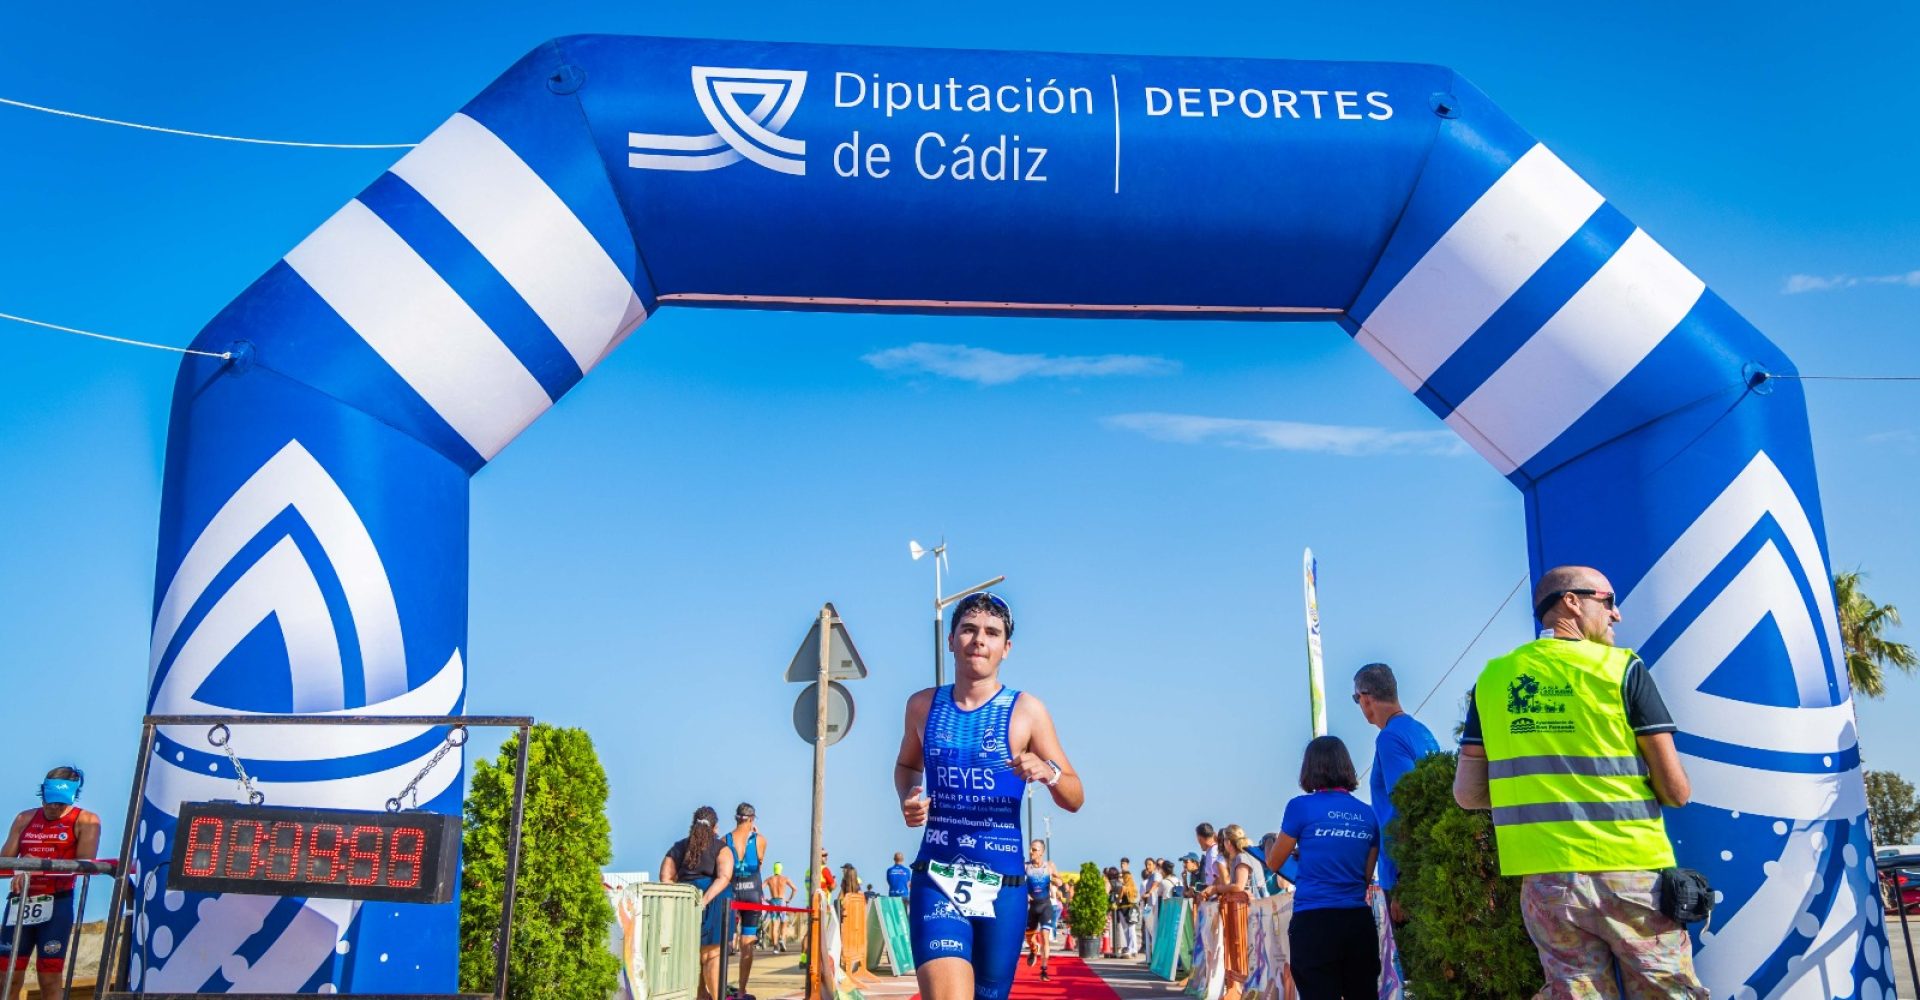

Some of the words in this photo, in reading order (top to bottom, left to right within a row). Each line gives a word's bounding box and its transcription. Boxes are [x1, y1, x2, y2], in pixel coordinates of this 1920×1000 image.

[834, 71, 1093, 117] Diputación
[1144, 86, 1394, 121] DEPORTES
[834, 131, 890, 179] de
[915, 131, 1048, 182] Cádiz
[937, 766, 995, 790] REYES
[1327, 811, 1365, 821] OFICIAL
[1314, 828, 1374, 841] triatlón
[953, 880, 973, 905] 5
